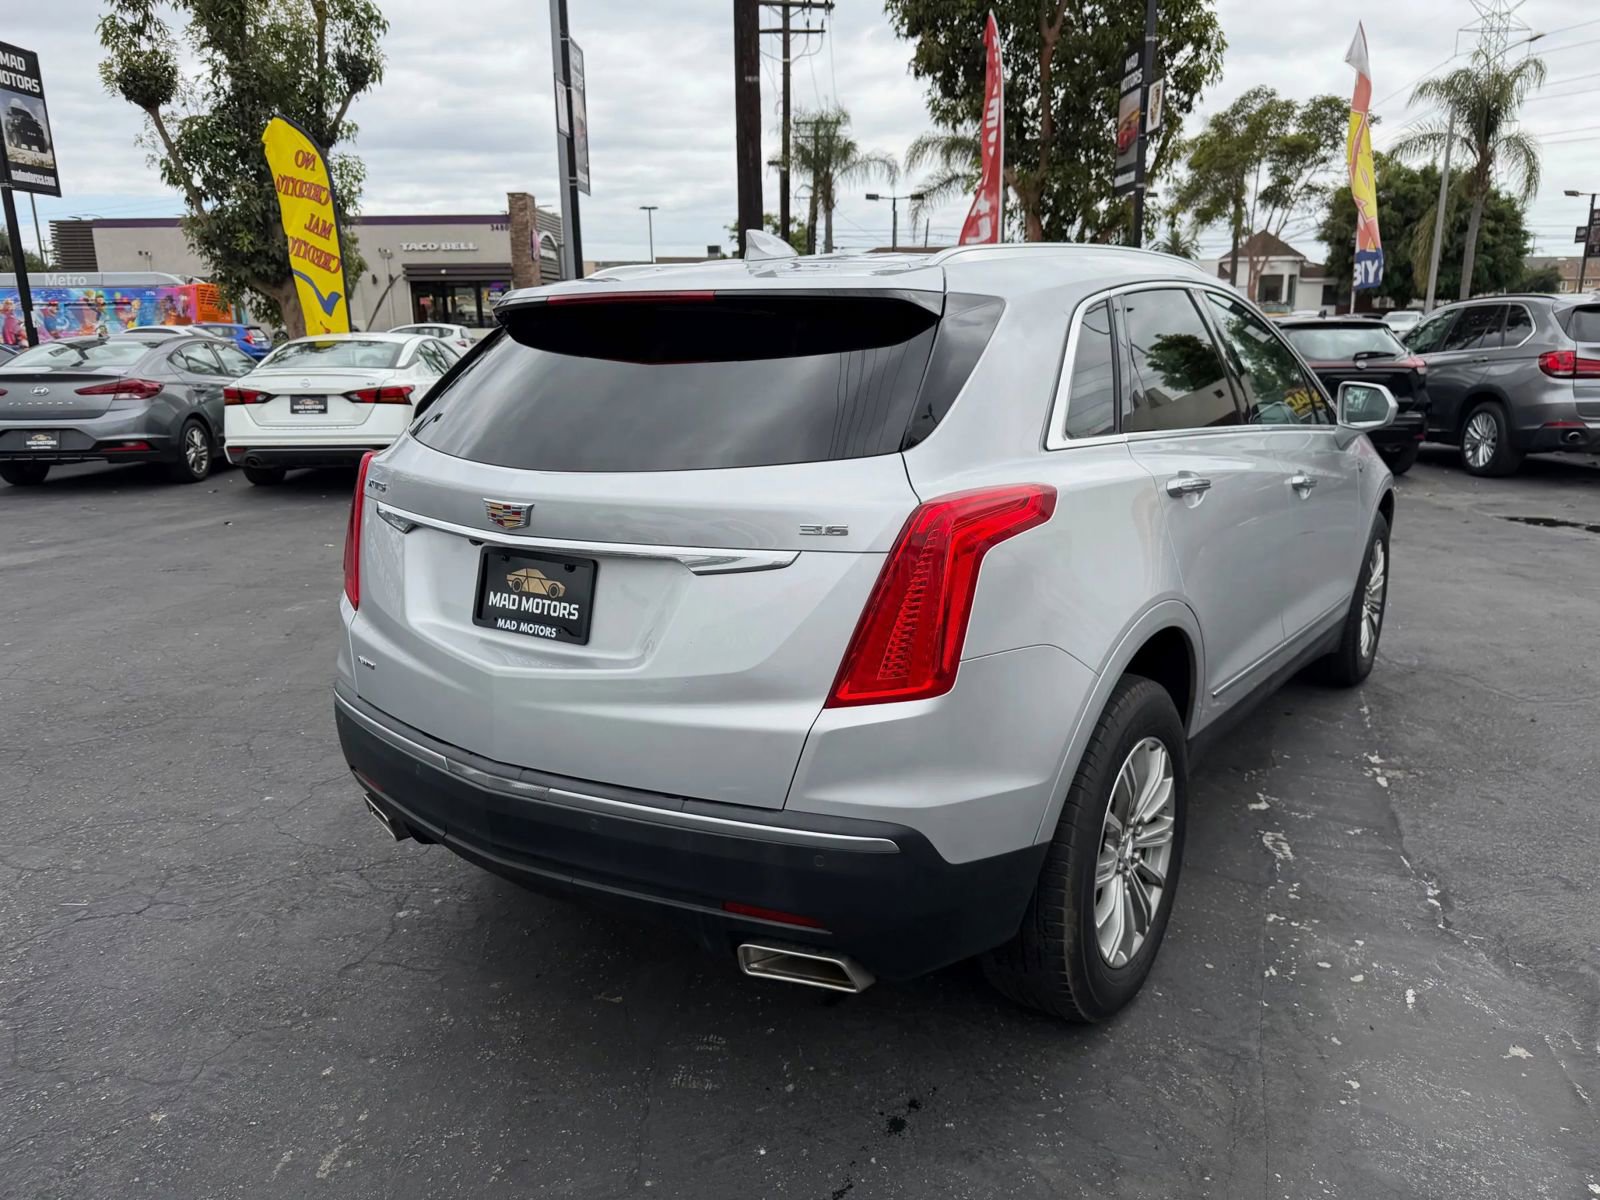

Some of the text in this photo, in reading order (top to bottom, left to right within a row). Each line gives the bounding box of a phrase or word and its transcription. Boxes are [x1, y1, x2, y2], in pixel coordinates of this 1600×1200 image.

[0, 52, 26, 72] MAD
[401, 242, 479, 251] TACO BELL
[45, 274, 87, 286] Metro
[488, 591, 579, 620] MAD MOTORS
[497, 618, 557, 638] MAD MOTORS
